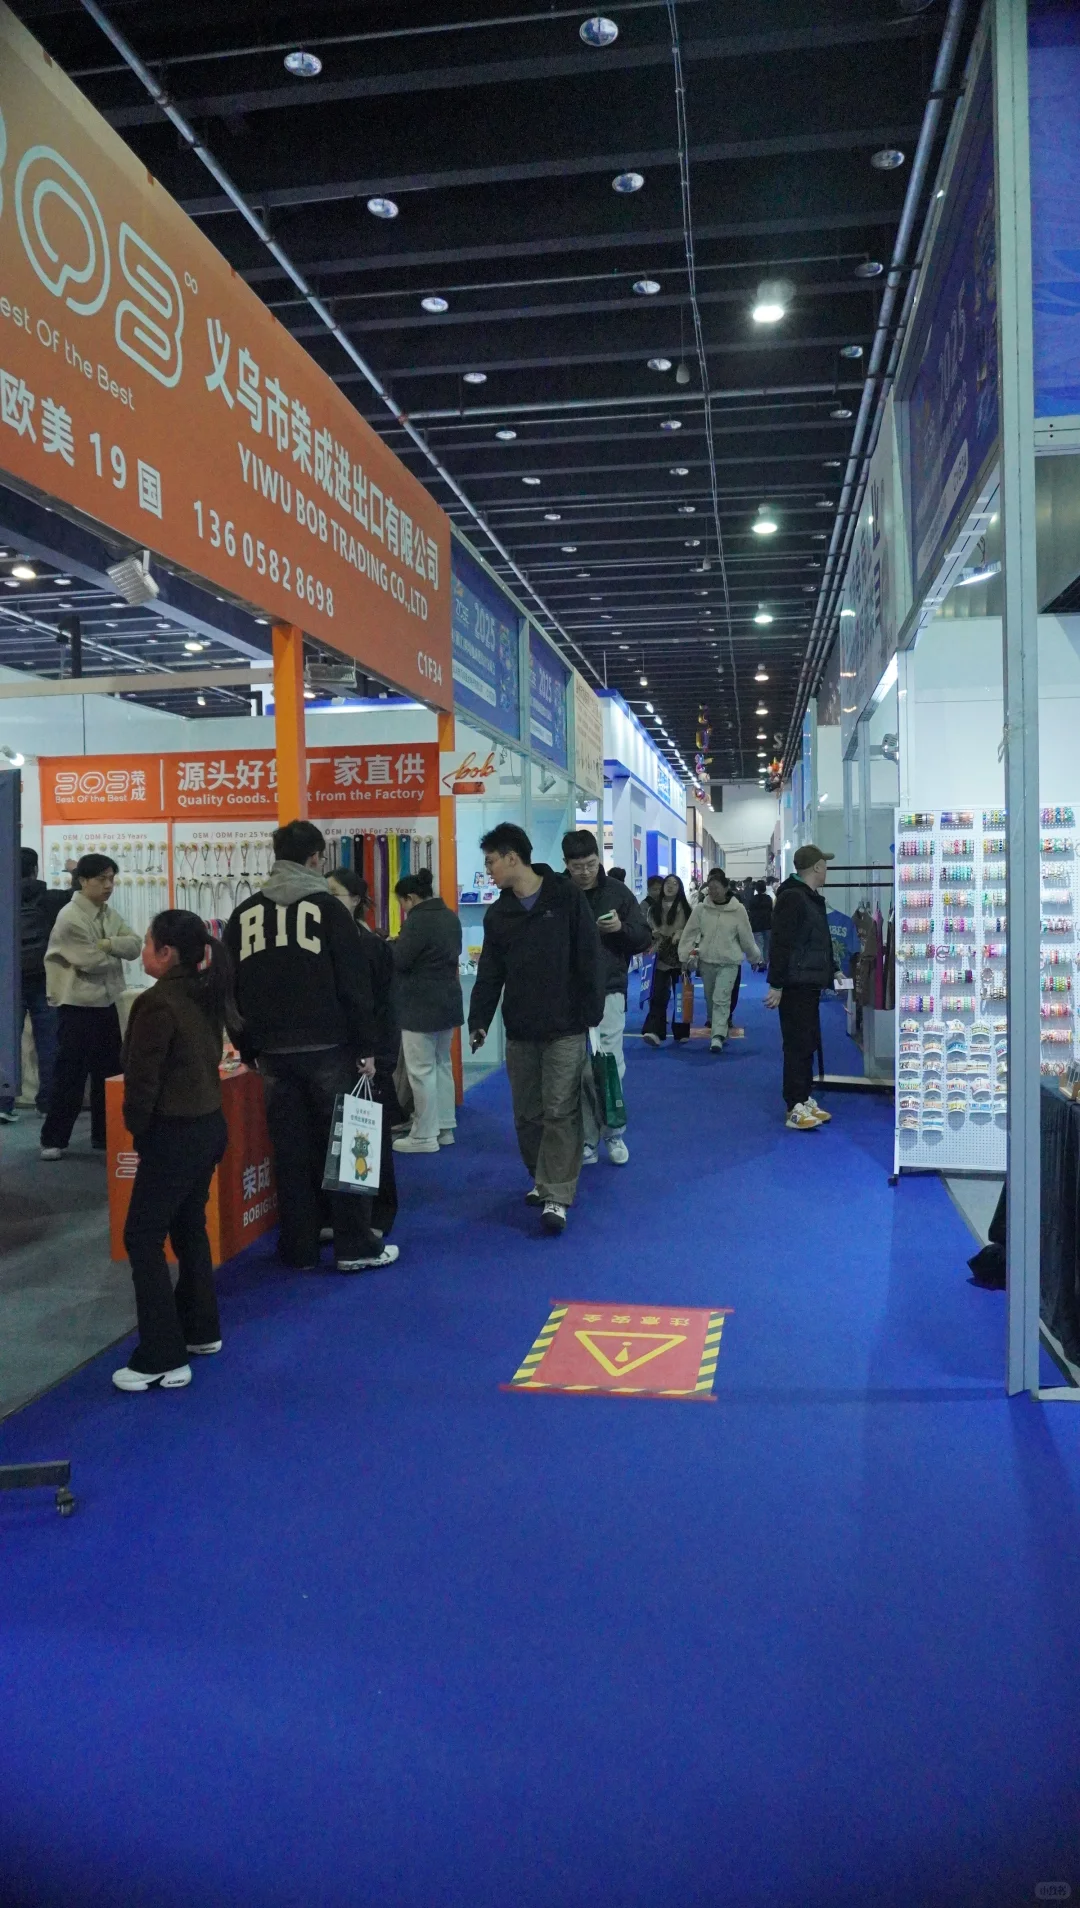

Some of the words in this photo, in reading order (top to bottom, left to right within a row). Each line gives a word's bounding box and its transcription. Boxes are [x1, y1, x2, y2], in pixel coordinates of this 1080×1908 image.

[0, 297, 31, 334] est
[36, 319, 60, 352] Of
[64, 337, 93, 379] the
[97, 364, 135, 411] Best
[89, 432, 126, 489] 19
[137, 458, 162, 519] 国
[205, 317, 440, 592] 义乌市荣成进出口有限公司
[237, 441, 292, 514] YIWU
[296, 488, 328, 543] BOB
[330, 518, 389, 592] TRADING
[193, 500, 236, 557] 136
[242, 532, 291, 592] 0582
[296, 565, 334, 618] 8698
[474, 602, 496, 652] 2025
[417, 650, 443, 687] C1F34
[56, 795, 75, 804] Best
[77, 795, 89, 803] Of
[90, 794, 106, 803] the
[107, 794, 128, 803] Best
[130, 770, 147, 801] 荣成
[177, 793, 224, 807] Quality
[226, 792, 270, 804] Goods.
[315, 790, 346, 801] from
[350, 789, 372, 801] the
[375, 788, 425, 801] Factory
[325, 828, 342, 836] OEM
[349, 827, 366, 835] ODM
[242, 1157, 271, 1201] 荣成
[582, 1313, 691, 1327] 注意安全
